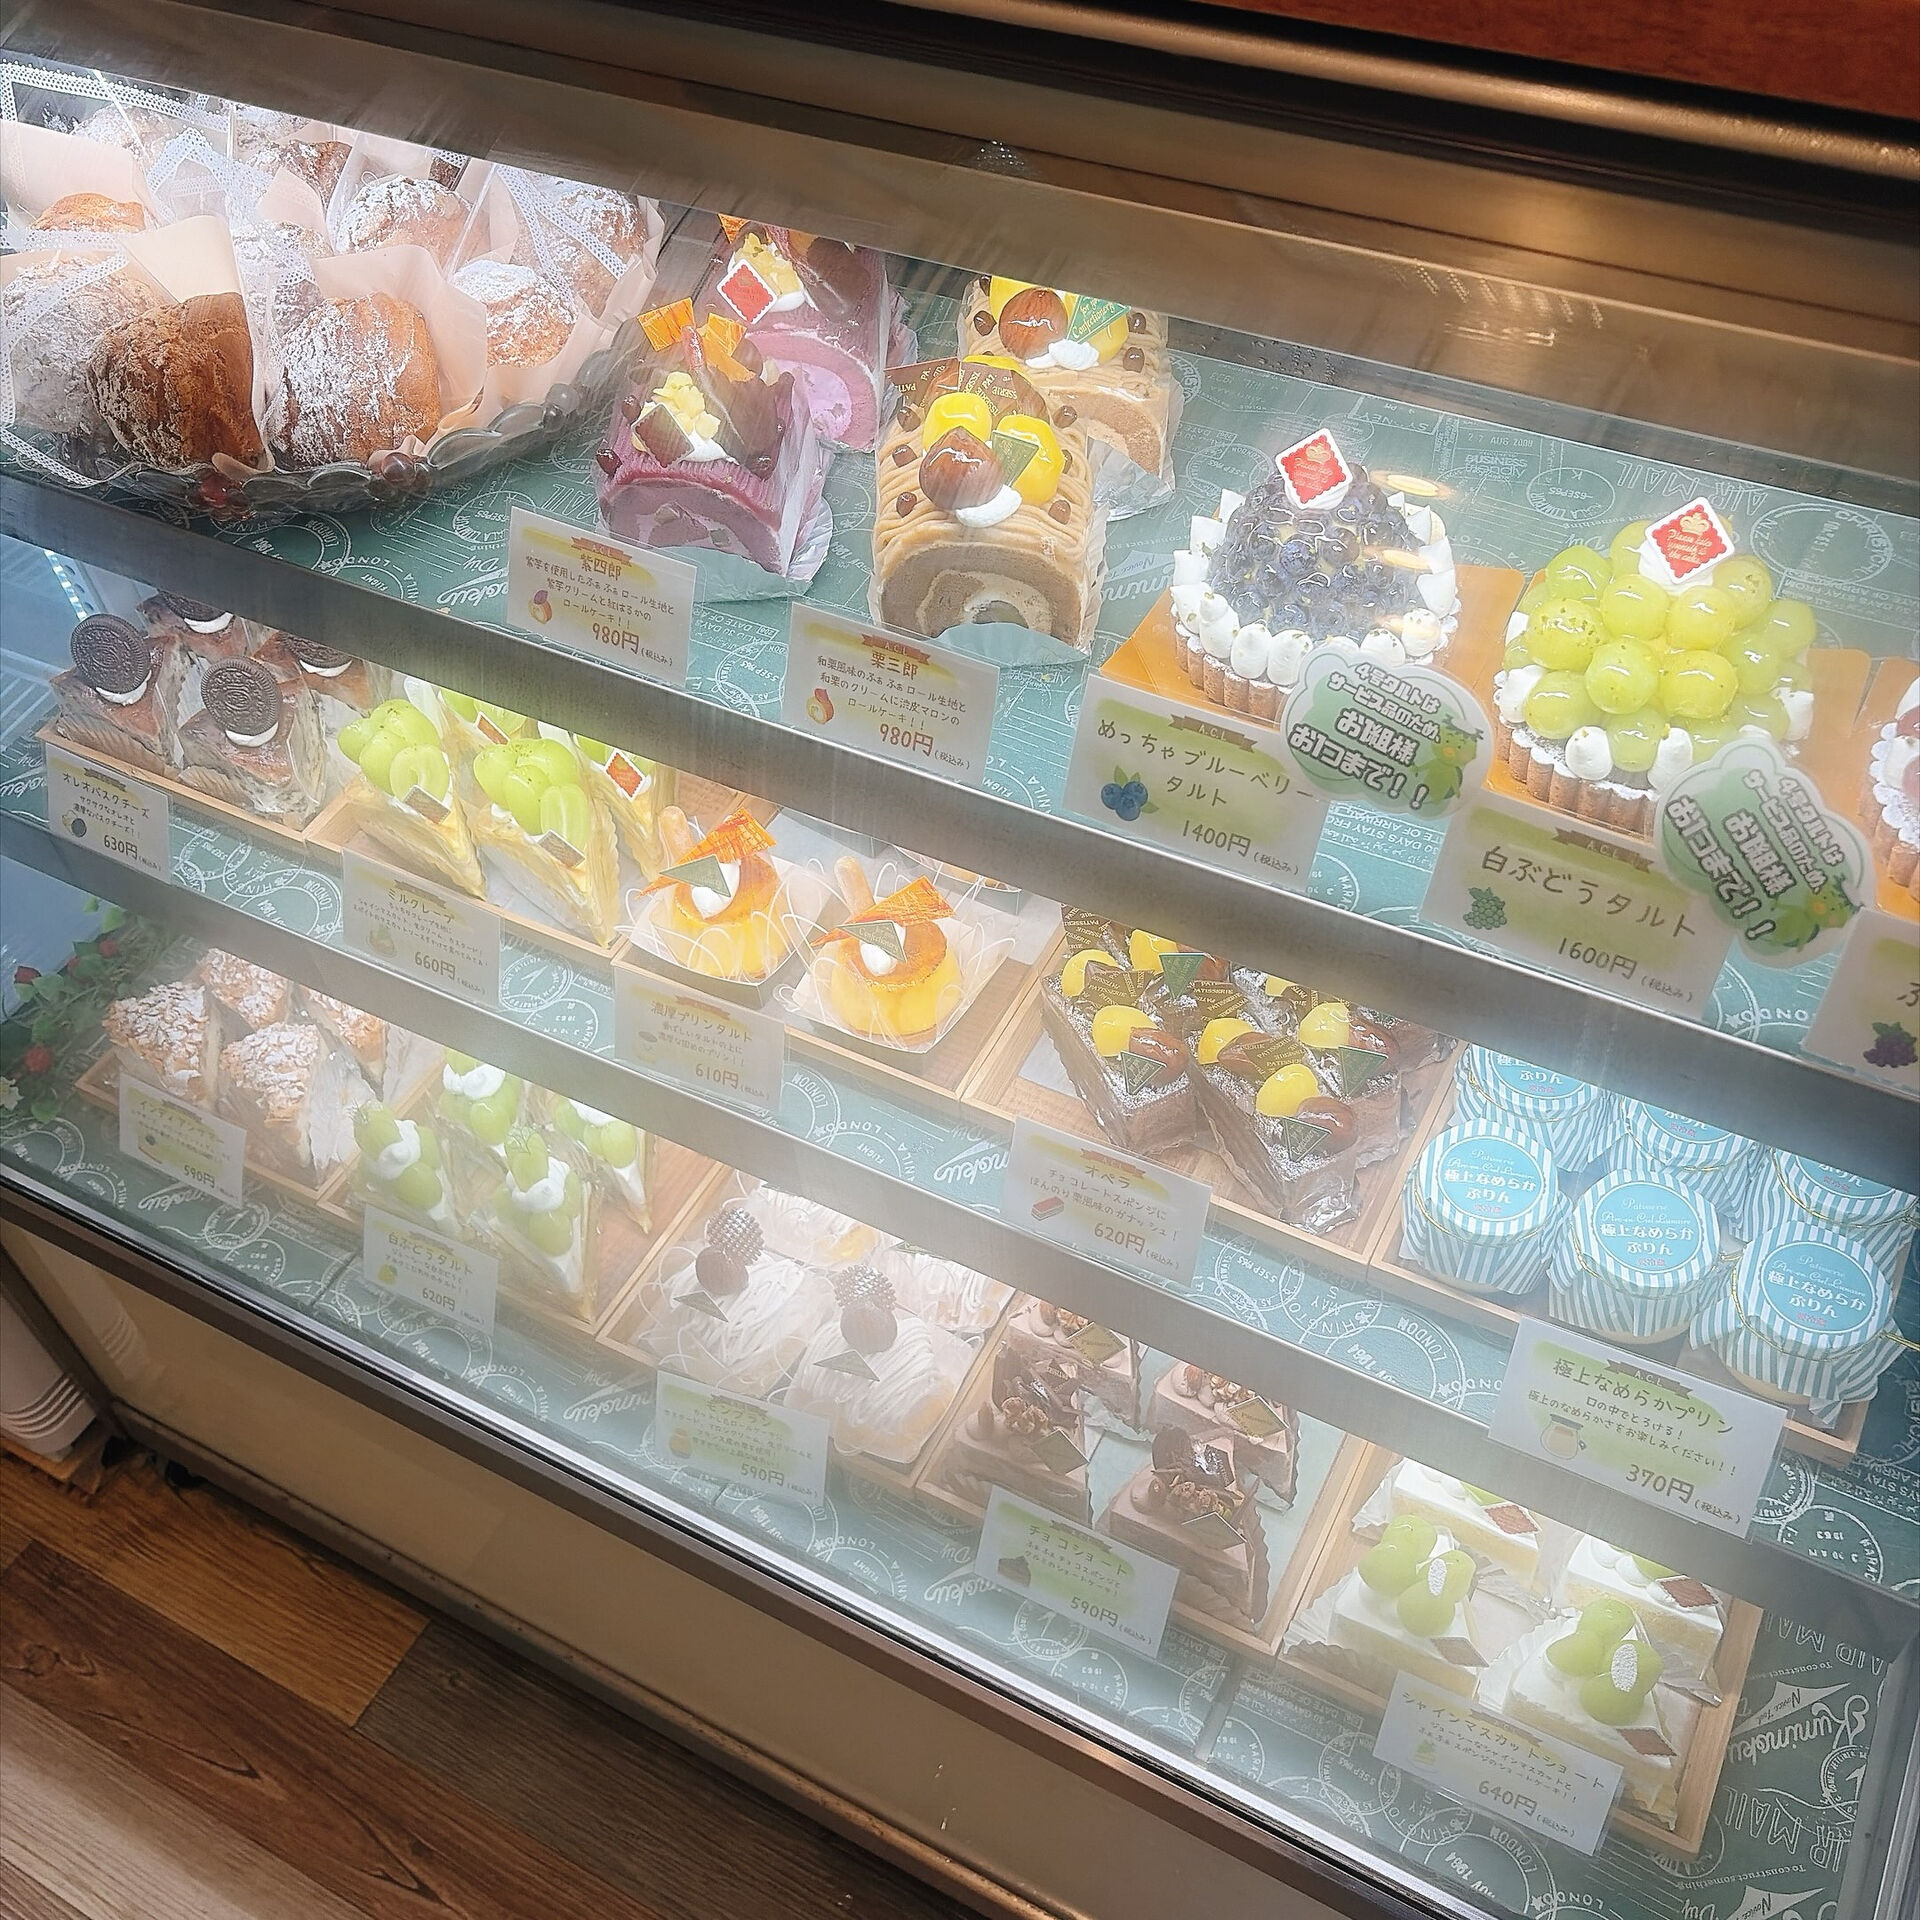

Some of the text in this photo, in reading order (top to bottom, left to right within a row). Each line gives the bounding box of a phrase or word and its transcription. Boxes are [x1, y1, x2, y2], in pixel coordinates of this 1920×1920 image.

[580, 554, 622, 581] 紫四郎
[592, 622, 640, 655] 980円
[871, 650, 919, 681] 栗三郎
[1355, 662, 1441, 714] 4号タルトは
[879, 722, 935, 757] 980円
[1097, 718, 1314, 798] めっちゃブルーベリー
[62, 772, 151, 820] オレオバスクチーズ
[1164, 776, 1229, 808] タルト
[103, 834, 138, 861] 630円
[1180, 819, 1299, 876] 1400円 (税込み)
[388, 887, 456, 924] ミルクレープ
[1480, 845, 1696, 940] 白ぶどうタルト
[414, 951, 456, 981] 660円
[1556, 936, 1637, 981] 1600円
[650, 1000, 753, 1042] 濃厚プリンタルト
[695, 1063, 739, 1090] 610円
[184, 1164, 216, 1189] 590円
[1084, 1163, 1131, 1190] オペラ
[1444, 1168, 1537, 1193] 極上なめらか
[1465, 1186, 1512, 1204] ぷりん
[1093, 1222, 1147, 1255] 620円
[1600, 1222, 1695, 1241] 極上なめらか
[1627, 1241, 1673, 1256] ぷりん
[421, 1287, 457, 1312] 620円
[1768, 1269, 1868, 1312] 極上なめらか
[1789, 1293, 1838, 1319] ぷりん
[1552, 1356, 1734, 1435] 極上なめらかプリン
[1585, 1394, 1684, 1441] 口の中でとろける！
[740, 1463, 786, 1487] 590円
[1625, 1463, 1742, 1525] 370円 (税込み)
[1027, 1524, 1128, 1577] チョコショート
[1070, 1596, 1120, 1628] 590円
[1401, 1691, 1606, 1790] シャインマスカットショート
[1478, 1779, 1538, 1818] 640円
